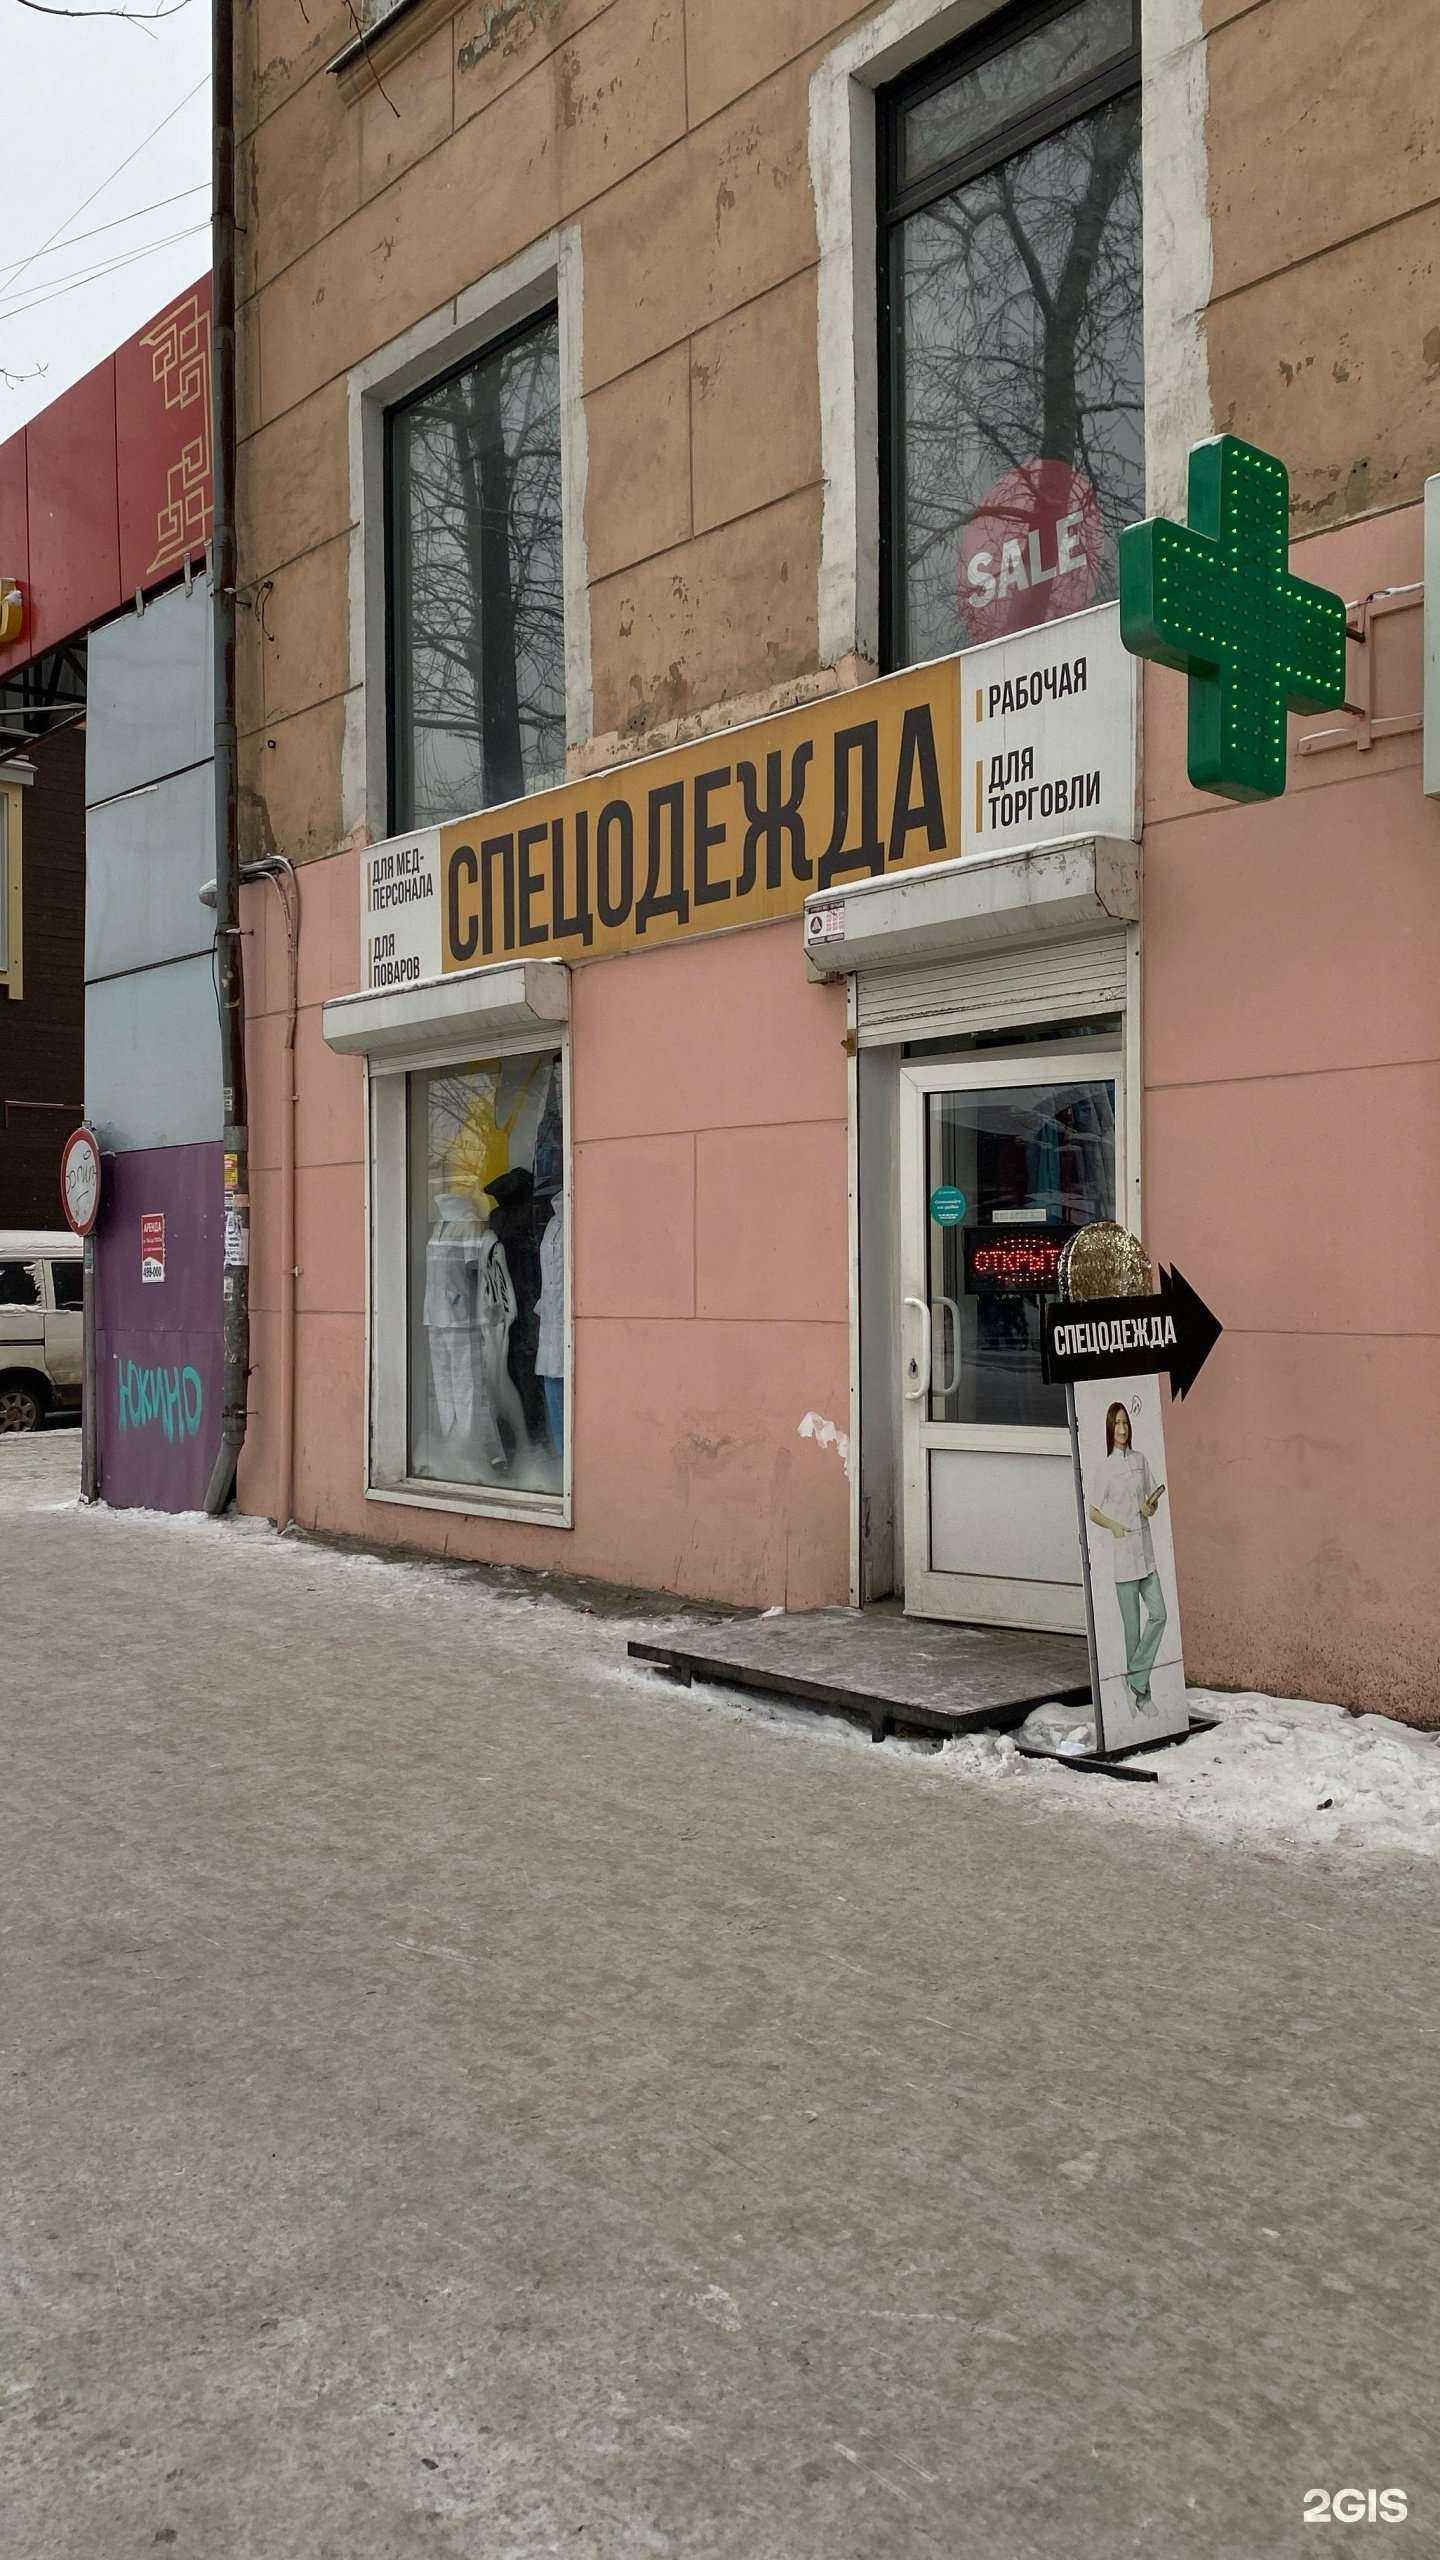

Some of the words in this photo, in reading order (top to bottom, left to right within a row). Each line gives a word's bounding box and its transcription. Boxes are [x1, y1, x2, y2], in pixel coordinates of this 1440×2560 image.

[967, 510, 1087, 608] SALE
[989, 657, 1087, 718] РАБОЧАЯ
[988, 746, 1034, 794] ДЛЯ
[988, 770, 1100, 829] ТОРГОВЛИ
[448, 703, 948, 962] СПЕЦОДЕЖДА
[372, 855, 394, 886] ДЛЯ
[396, 848, 425, 876] МЕД-
[373, 873, 434, 911] ПЕРСОНАЛА
[373, 933, 395, 963] ДЛЯ
[373, 956, 421, 988] ПОВАРОВ
[975, 1249, 1061, 1271] ОТКРЫТ
[1053, 1315, 1178, 1356] СПЕЦОДЕЖДА
